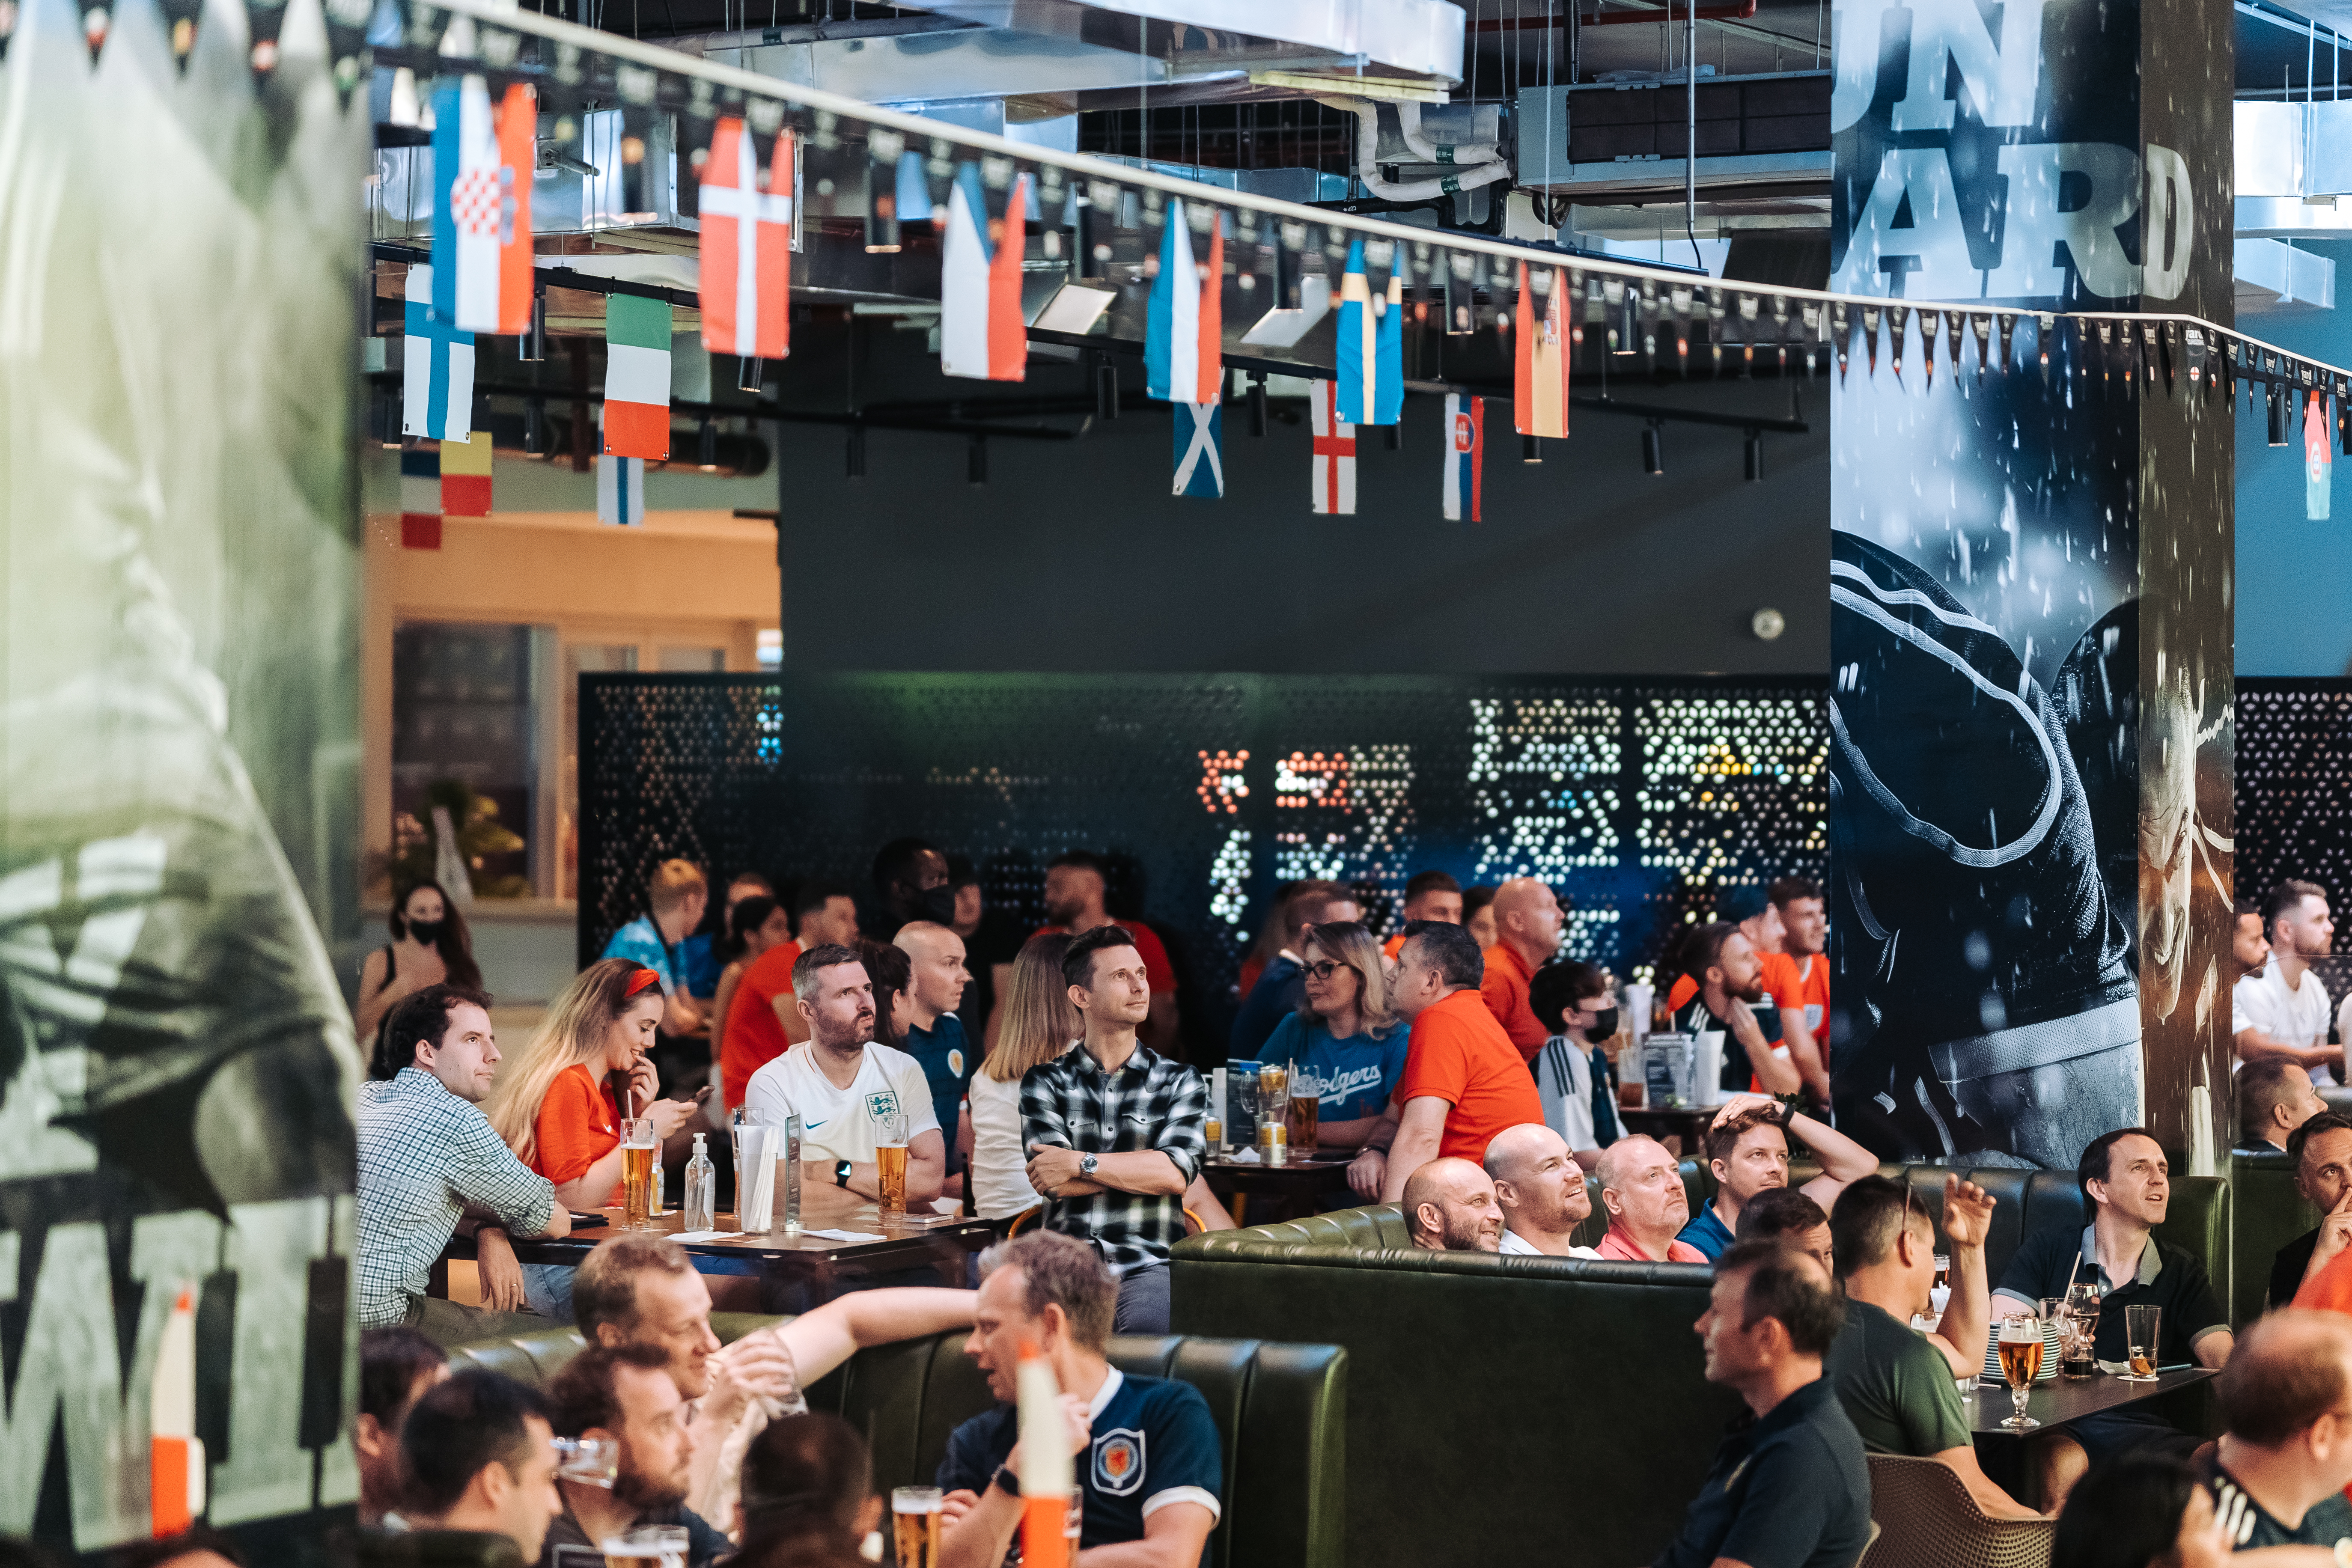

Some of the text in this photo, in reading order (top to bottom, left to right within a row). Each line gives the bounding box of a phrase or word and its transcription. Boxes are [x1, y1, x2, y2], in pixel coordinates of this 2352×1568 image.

[1831, 140, 2194, 301] ARD
[2301, 370, 2312, 381] yard
[1297, 1064, 1381, 1106] odgers
